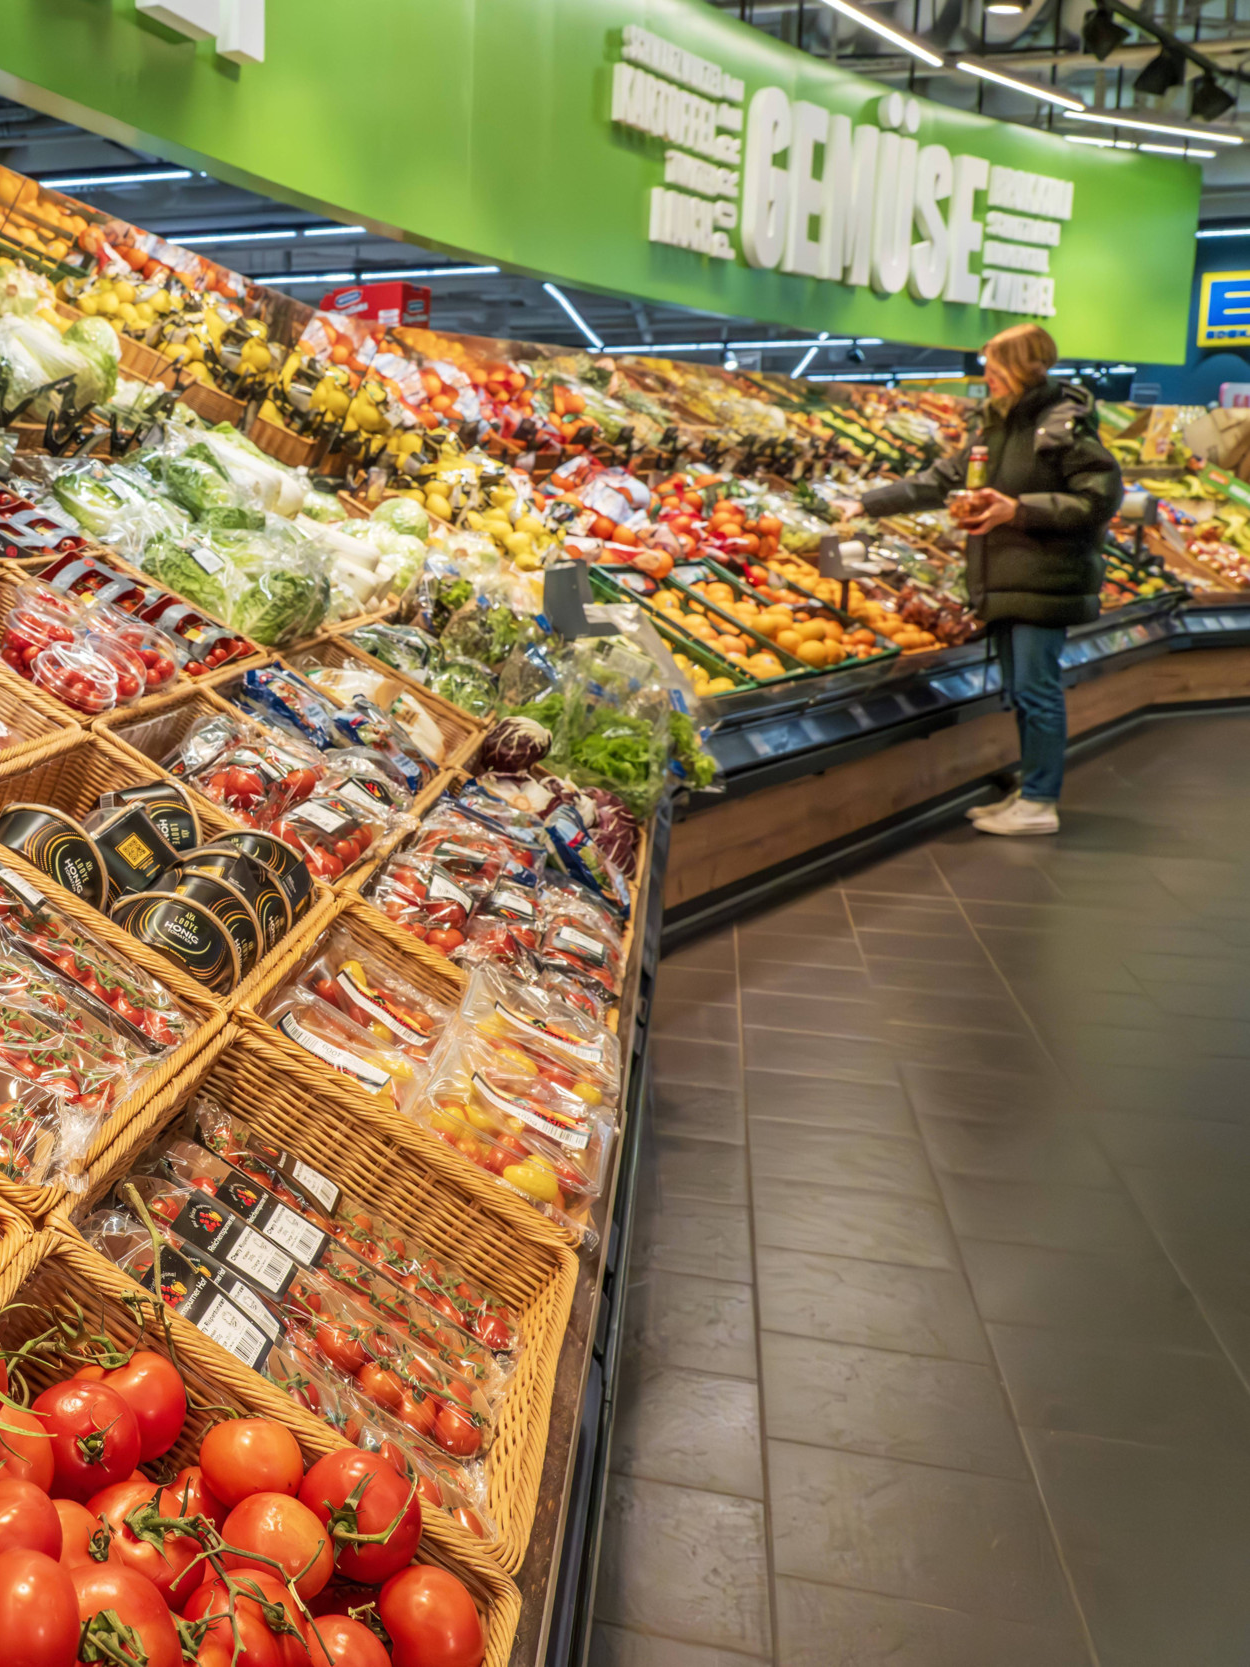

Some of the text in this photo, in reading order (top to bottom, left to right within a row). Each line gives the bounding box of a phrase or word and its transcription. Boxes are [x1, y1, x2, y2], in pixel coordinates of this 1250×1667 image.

[611, 61, 716, 152] KARTOFFEL
[743, 86, 990, 305] GEMÜSE
[64, 858, 83, 895] HONIG
[64, 867, 76, 892] TOMATEN
[74, 858, 89, 883] LOOYE
[164, 921, 199, 945] HONIG
[167, 929, 193, 945] TOMATEN
[174, 916, 198, 933] LOOYE
[196, 1277, 208, 1290] Hof
